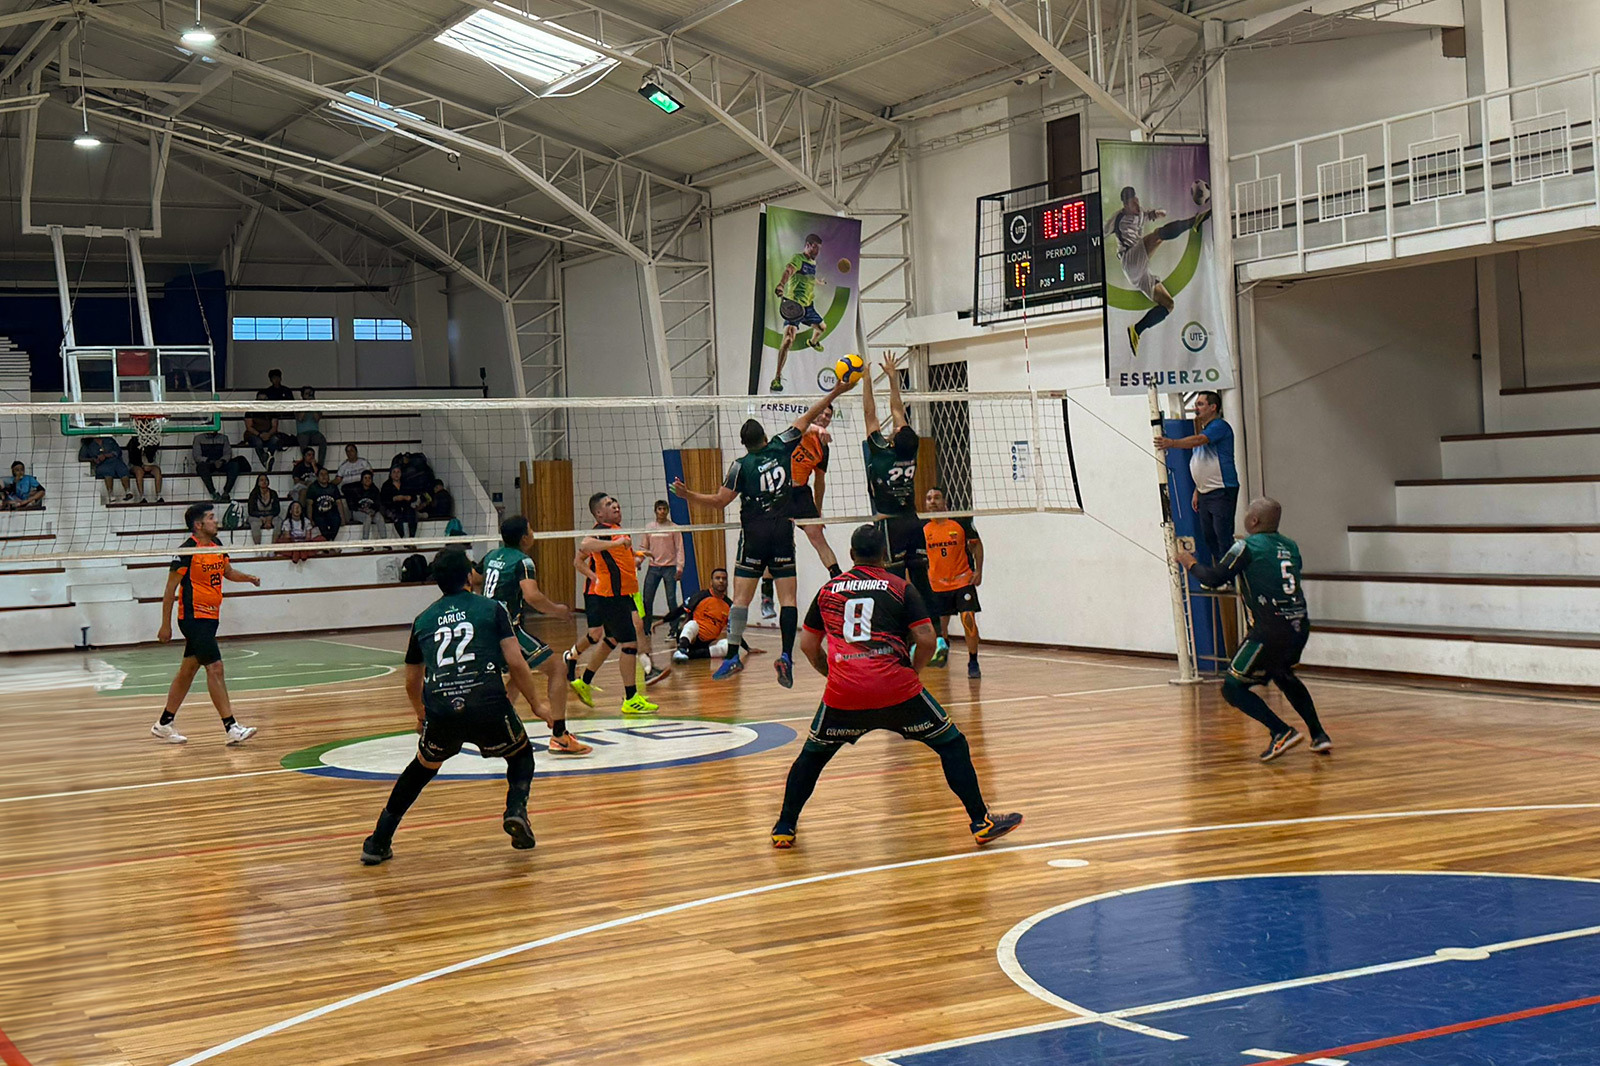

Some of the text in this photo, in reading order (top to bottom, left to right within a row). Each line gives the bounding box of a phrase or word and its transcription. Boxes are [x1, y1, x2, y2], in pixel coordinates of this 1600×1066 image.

[1007, 250, 1032, 263] LOCAL
[1046, 245, 1077, 259] PERIODO
[1189, 332, 1204, 342] UTE
[888, 465, 916, 481] 29
[483, 567, 500, 599] 10
[1280, 560, 1296, 595] 5
[831, 579, 889, 594] COLMENARES
[437, 611, 467, 626] CARLOS
[843, 597, 875, 643] 8
[434, 621, 476, 668] 22
